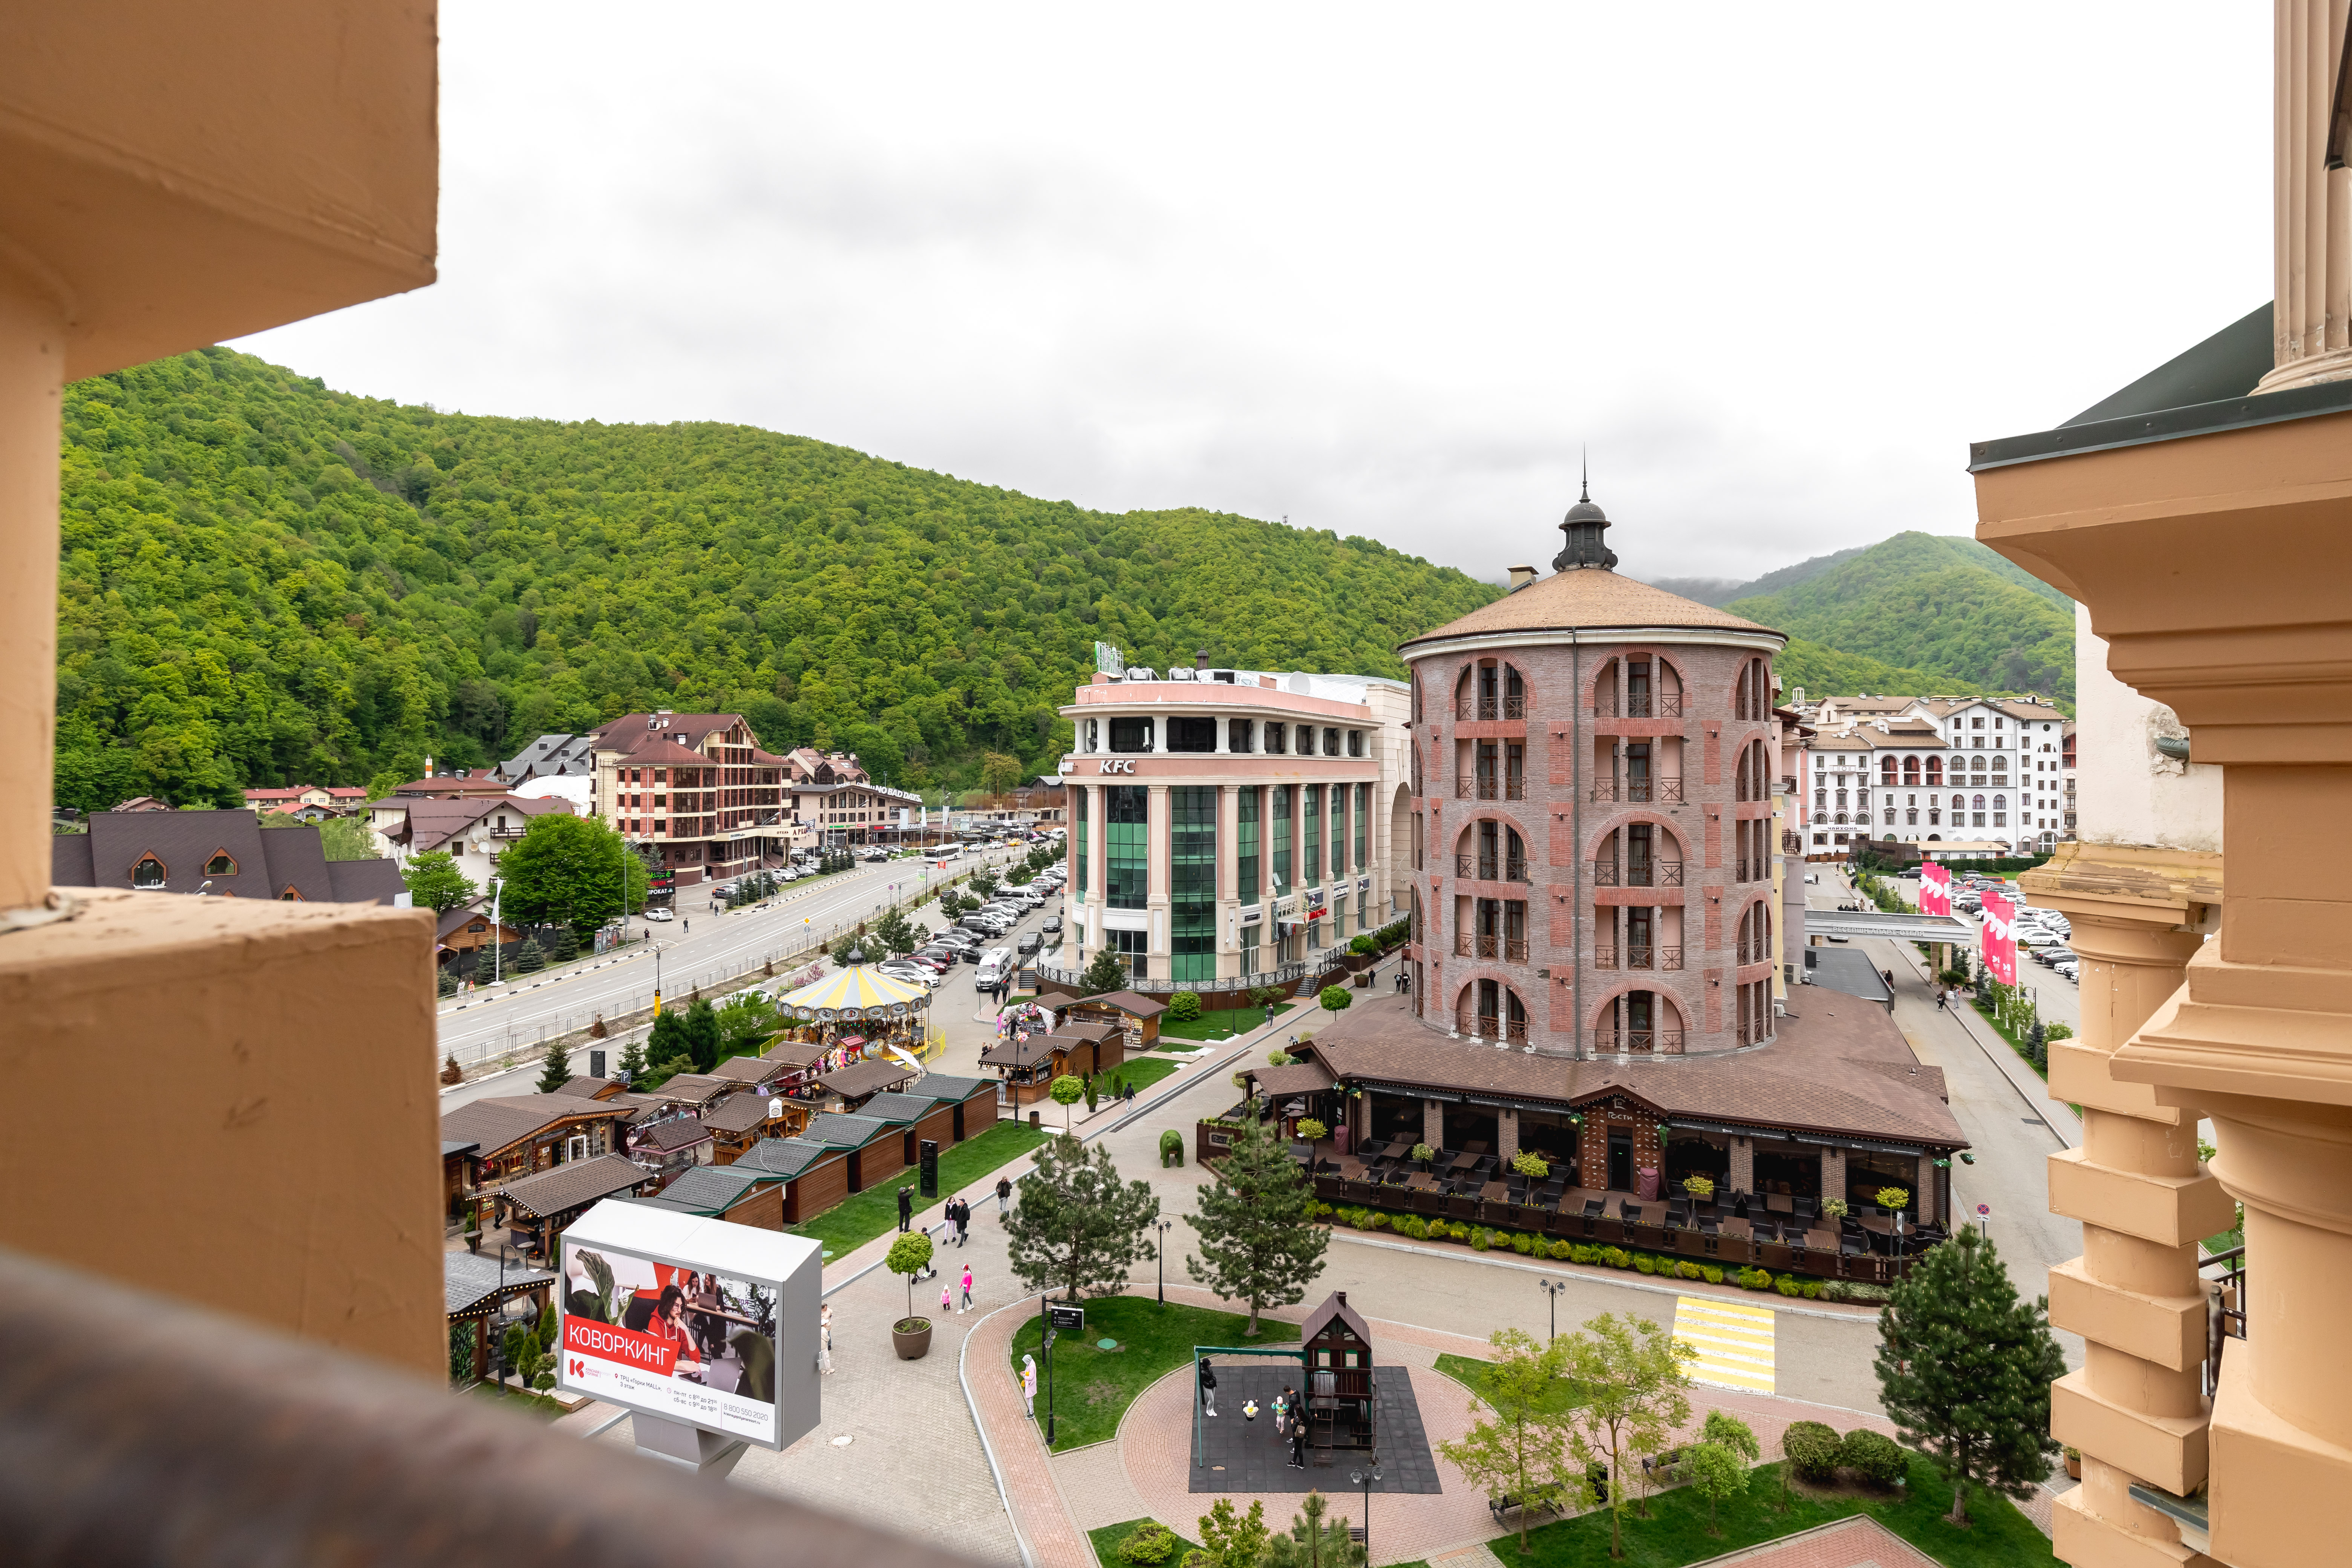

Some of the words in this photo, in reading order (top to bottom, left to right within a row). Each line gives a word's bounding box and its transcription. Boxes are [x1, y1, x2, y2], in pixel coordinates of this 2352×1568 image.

[1098, 760, 1135, 773] KFC
[875, 785, 887, 794] NO
[887, 788, 903, 798] BAD
[623, 1072, 629, 1081] P
[1608, 1112, 1633, 1121] Гости
[570, 1324, 670, 1366] КОВОРКИНГ
[630, 1378, 645, 1387] «Горки
[646, 1381, 662, 1392] MALL»,
[729, 1405, 740, 1414] 800
[741, 1408, 752, 1417] 550
[753, 1411, 768, 1421] 2020
